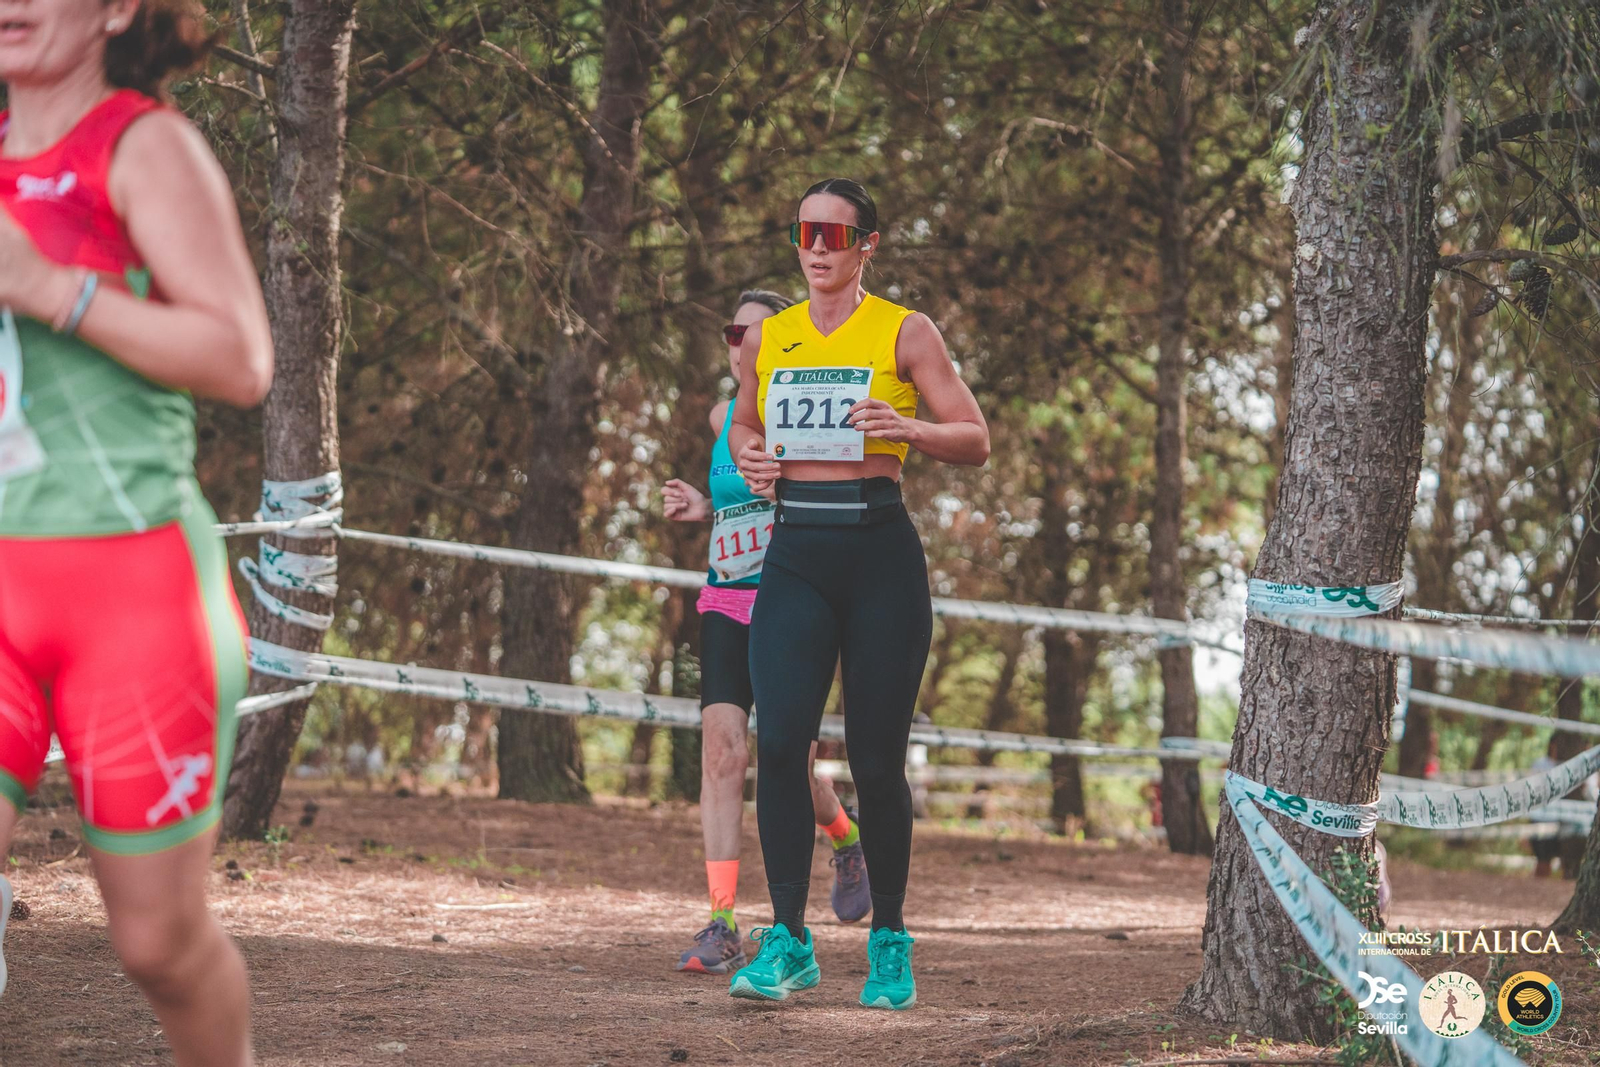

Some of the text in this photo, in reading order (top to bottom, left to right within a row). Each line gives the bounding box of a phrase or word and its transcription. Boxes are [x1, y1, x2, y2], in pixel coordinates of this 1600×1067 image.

[799, 370, 843, 382] ITÁLICA
[776, 398, 857, 429] 1212
[1311, 809, 1362, 830] Sevilla
